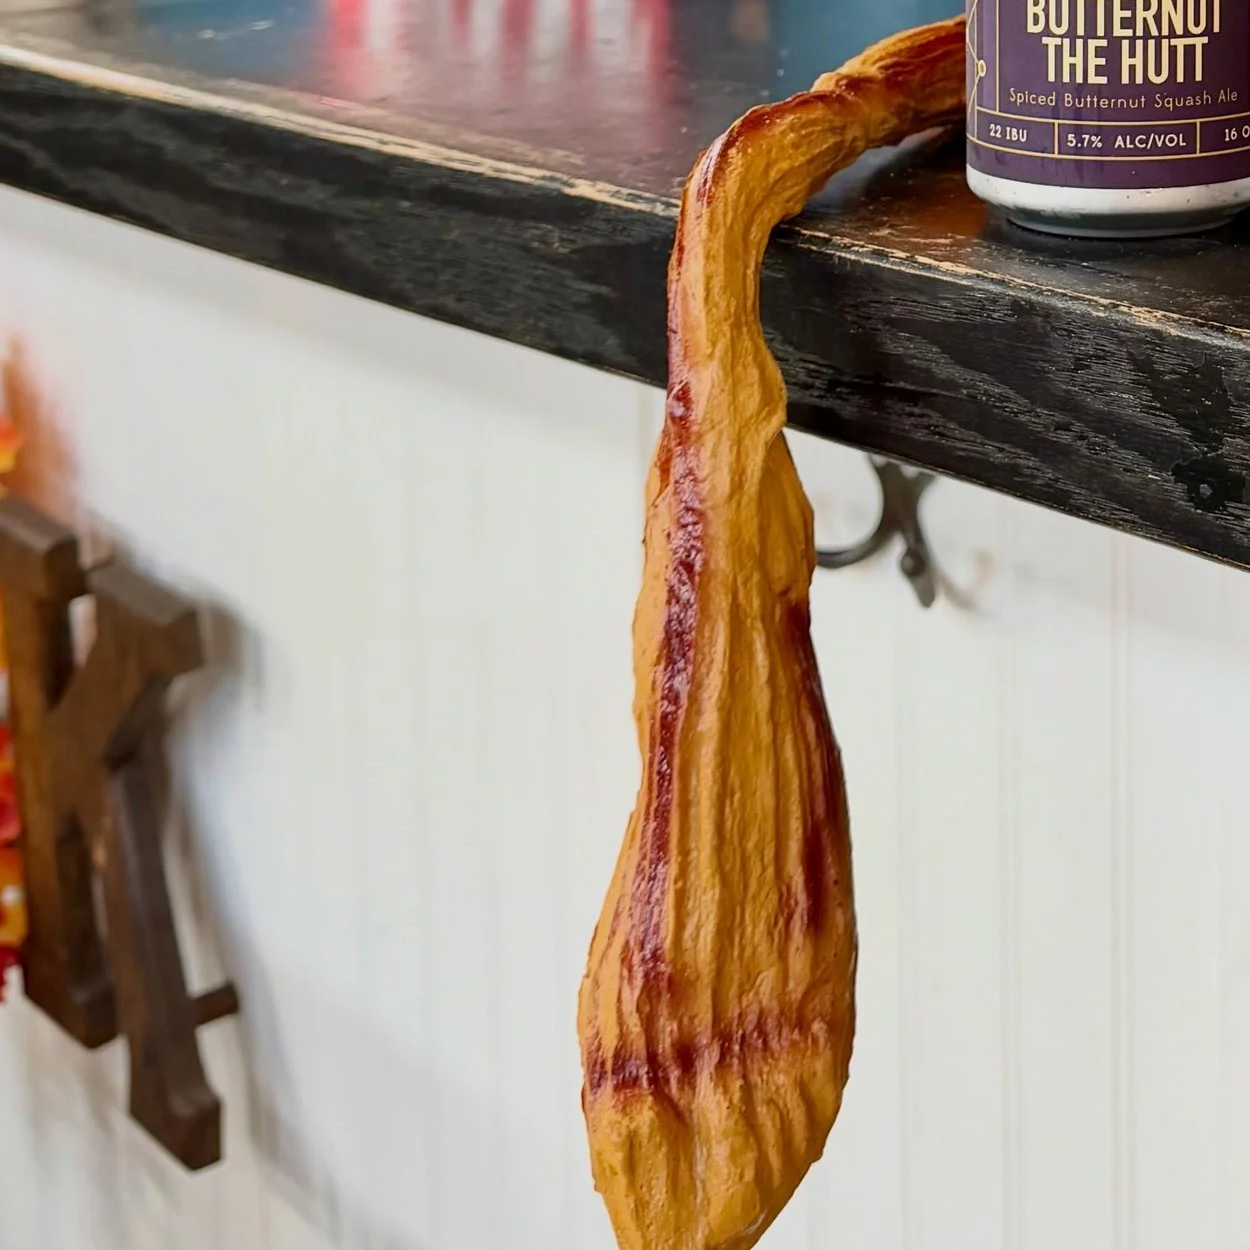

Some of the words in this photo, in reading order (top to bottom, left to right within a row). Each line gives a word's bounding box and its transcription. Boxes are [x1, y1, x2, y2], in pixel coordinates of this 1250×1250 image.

[1041, 36, 1108, 84] THE
[1120, 36, 1209, 85] HUTT
[1009, 87, 1056, 107] Spiced
[1064, 92, 1146, 109] Butternut
[1154, 90, 1212, 112] Squash
[1217, 87, 1238, 103] Ale
[989, 123, 1002, 138] 22
[1005, 126, 1027, 143] IBU
[1066, 133, 1103, 148] 5.7%
[1114, 133, 1187, 150] ALC/VOL
[1224, 127, 1238, 142] 16
